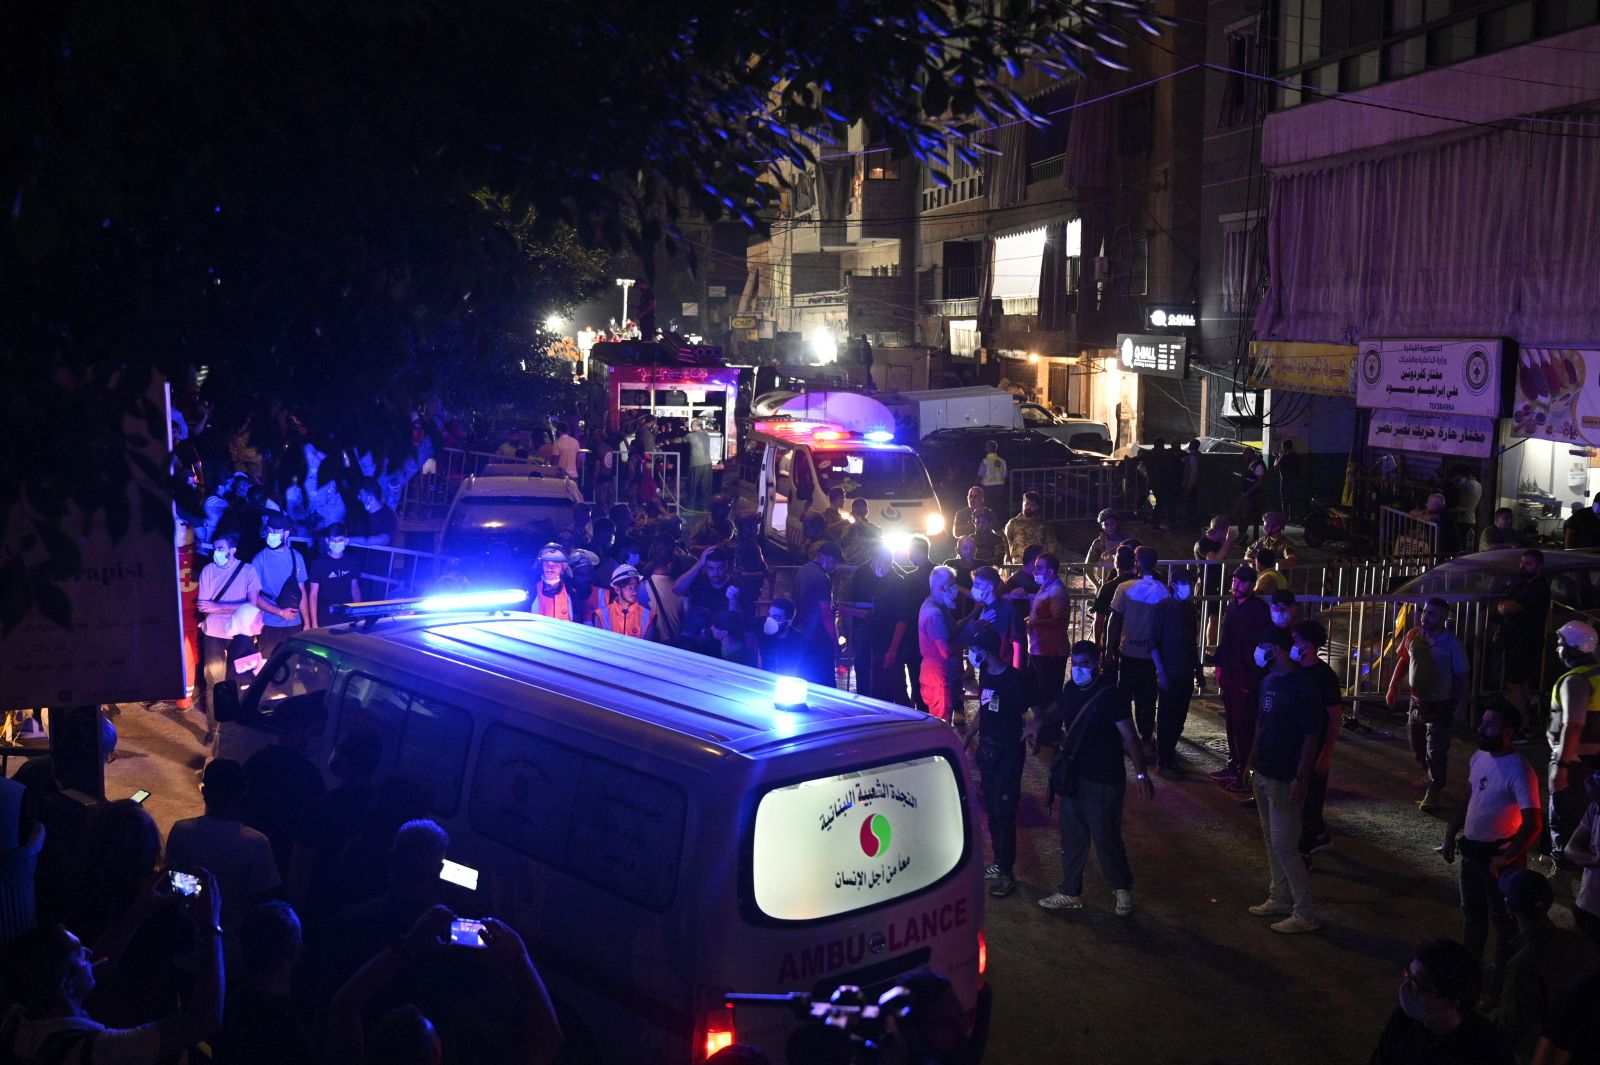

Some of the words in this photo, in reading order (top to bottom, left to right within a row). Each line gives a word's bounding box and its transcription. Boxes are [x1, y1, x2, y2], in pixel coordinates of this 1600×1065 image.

[1426, 369, 1443, 382] مختار
[1446, 386, 1459, 401] علي
[1375, 422, 1393, 436] نصر
[1392, 423, 1411, 437] نصر
[1412, 423, 1436, 439] حريك
[1438, 426, 1458, 442] حارة
[1458, 429, 1486, 444] مختار
[855, 778, 890, 807] الشعبية
[889, 783, 918, 809] النجدة
[819, 787, 856, 831] اللبنانية
[868, 863, 886, 889] أجل
[885, 865, 897, 884] من
